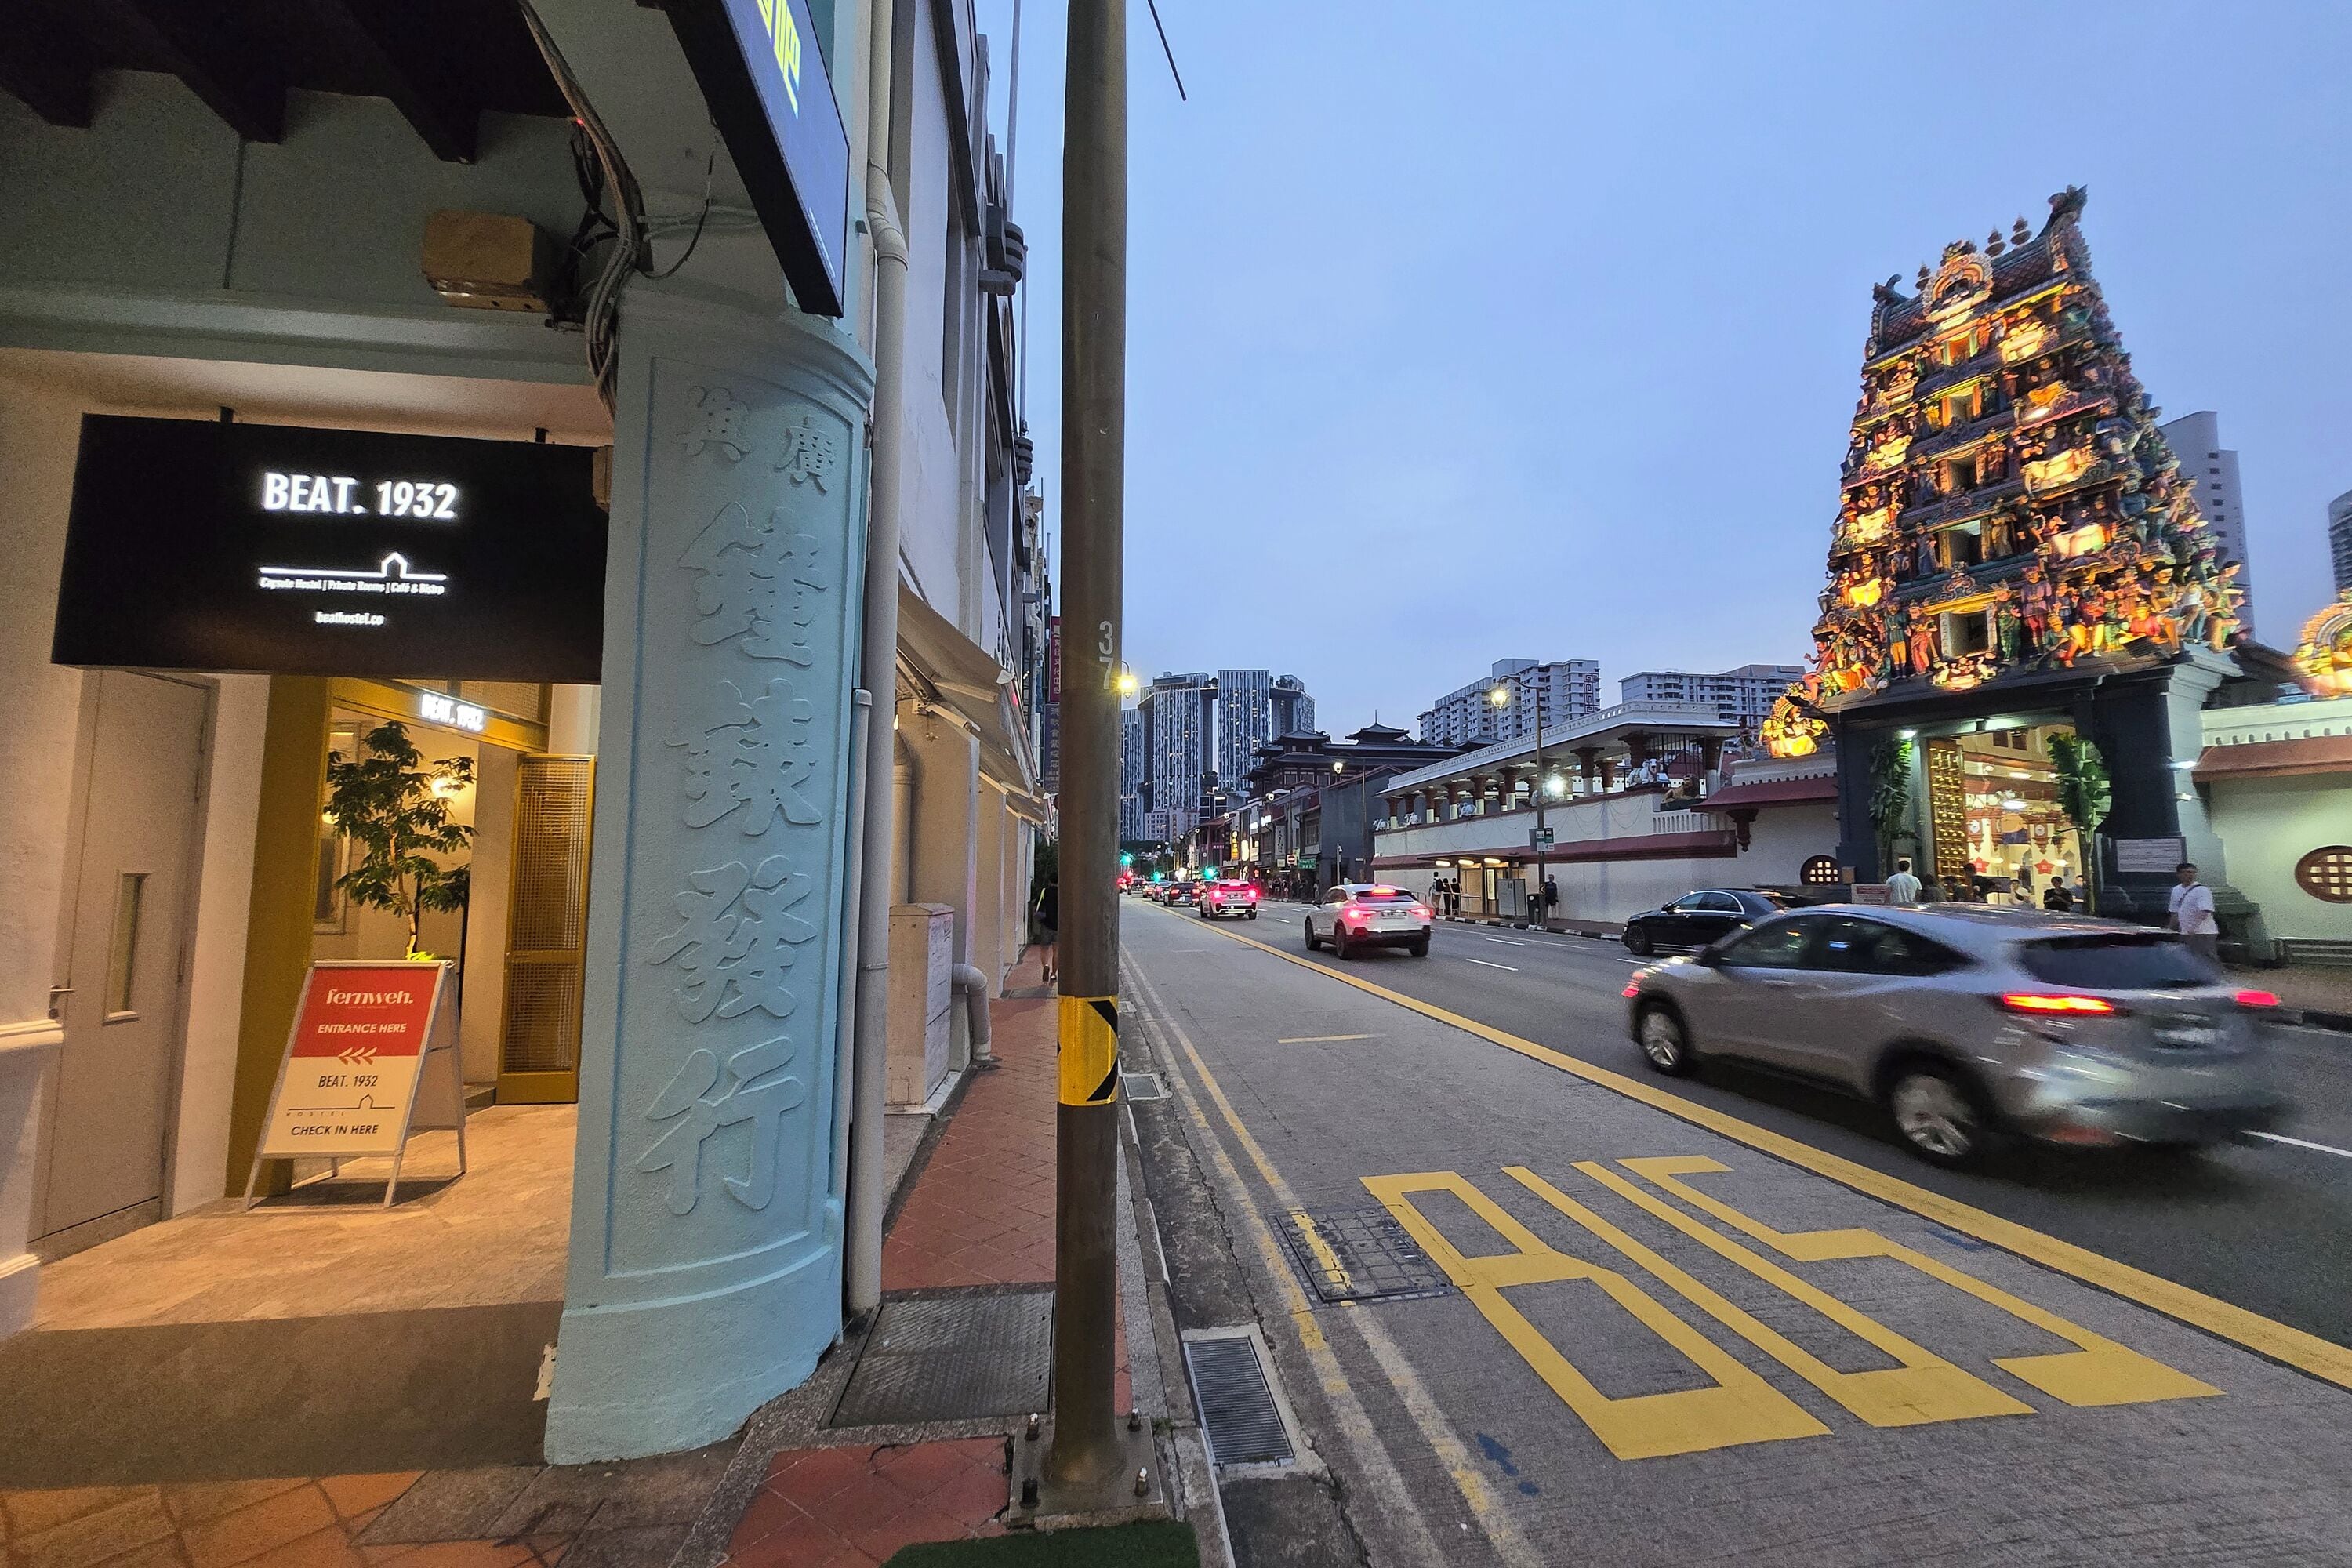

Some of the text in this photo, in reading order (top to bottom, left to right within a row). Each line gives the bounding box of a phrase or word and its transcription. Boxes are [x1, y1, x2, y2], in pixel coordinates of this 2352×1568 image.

[263, 471, 457, 519] BEAT. 1932
[295, 579, 321, 590] Hostel
[328, 581, 357, 591] Private
[357, 582, 384, 593] Rooms
[419, 584, 445, 595] Bistro
[315, 612, 384, 626] beathostel.co
[326, 989, 414, 1004] fernweh.
[318, 1023, 407, 1033] ENTRANCE HERE
[318, 1075, 379, 1088] BEAT. 1932
[291, 1124, 379, 1135] CHECK IN HERE
[1360, 1155, 2225, 1461] BUS
